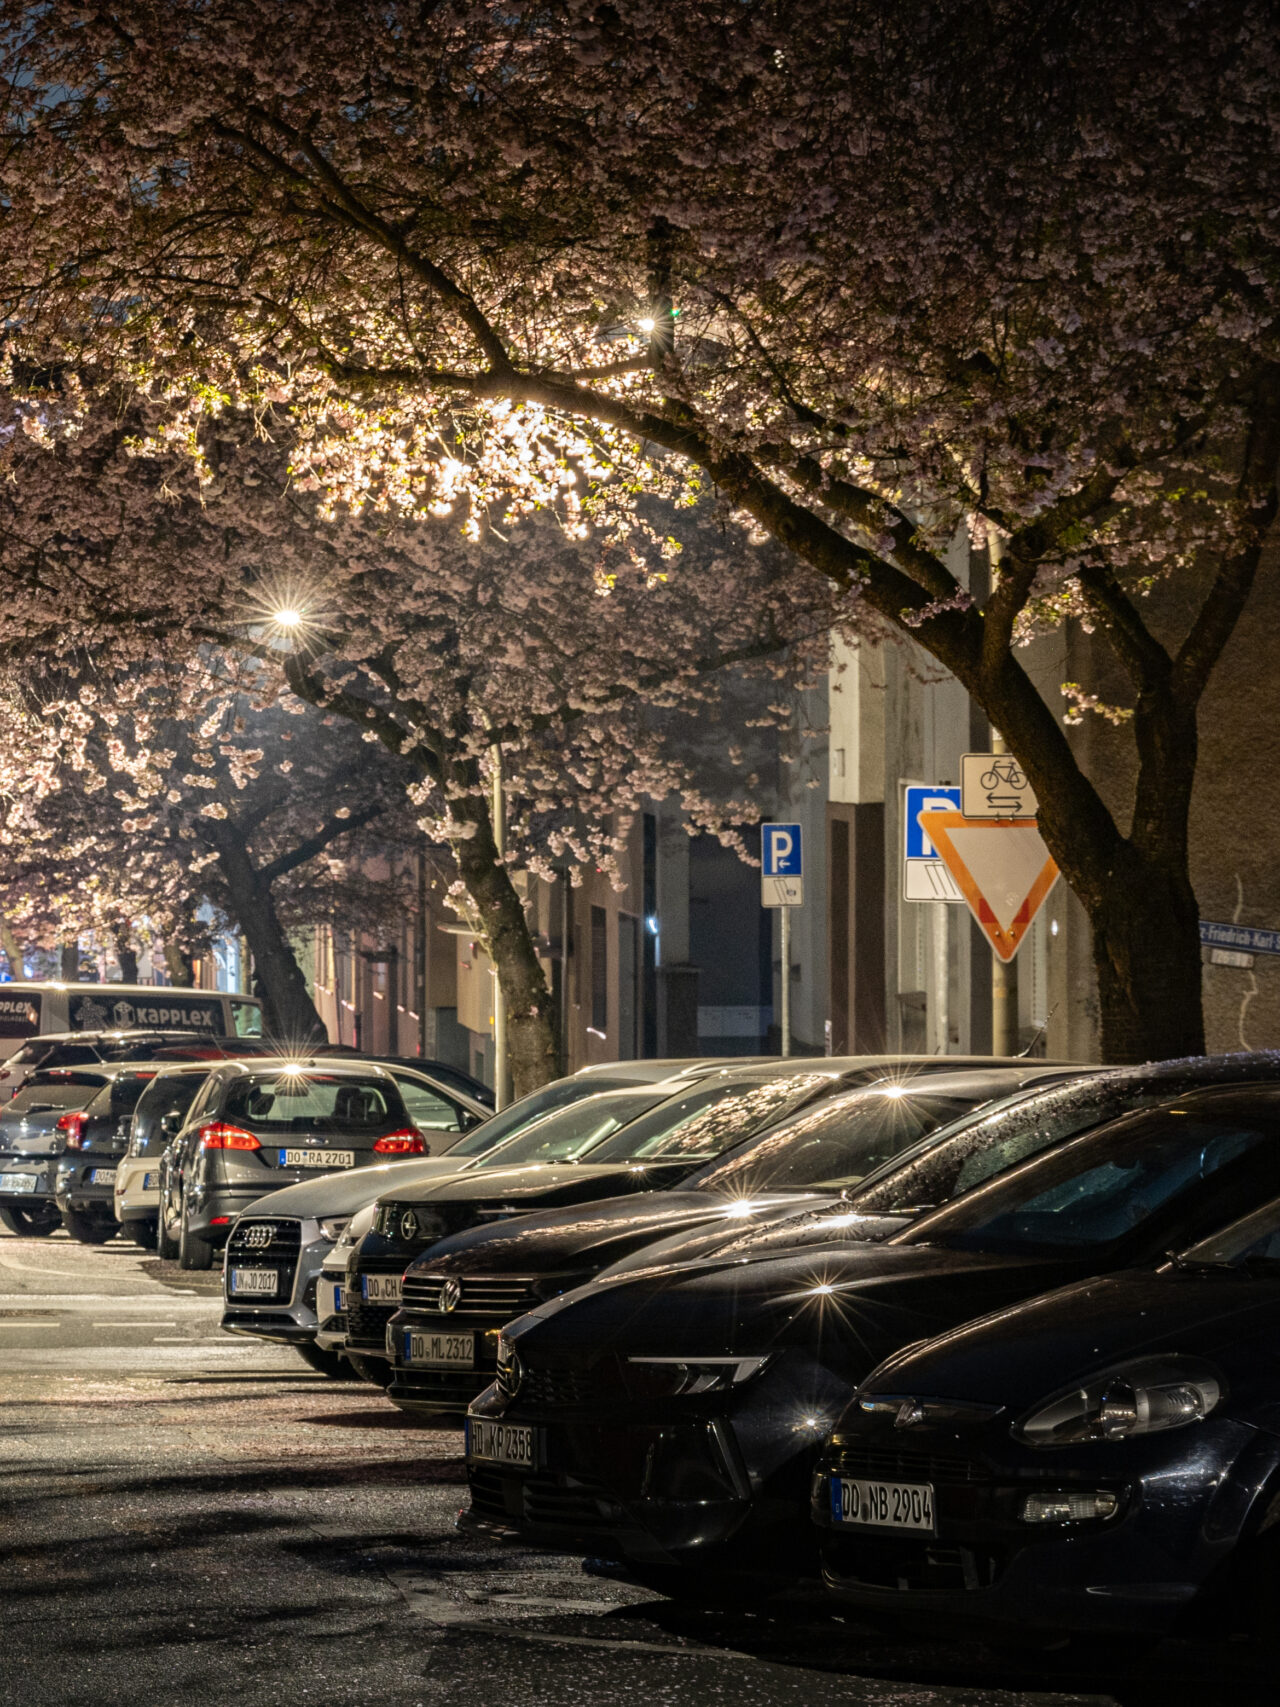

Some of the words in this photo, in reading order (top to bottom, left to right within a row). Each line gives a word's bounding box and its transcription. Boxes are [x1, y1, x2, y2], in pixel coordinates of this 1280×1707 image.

[771, 831, 793, 873] P
[287, 1152, 300, 1163] DO
[309, 1152, 322, 1164] RA
[325, 1153, 352, 1165] 2701
[259, 1273, 276, 1290] 2017
[368, 1278, 379, 1297] DO
[385, 1278, 397, 1297] CH
[412, 1336, 424, 1358] DO
[432, 1337, 445, 1359] ML
[446, 1338, 473, 1360] 2312
[842, 1483, 860, 1518] DO
[869, 1485, 888, 1520] NB
[893, 1488, 931, 1525] 2904
